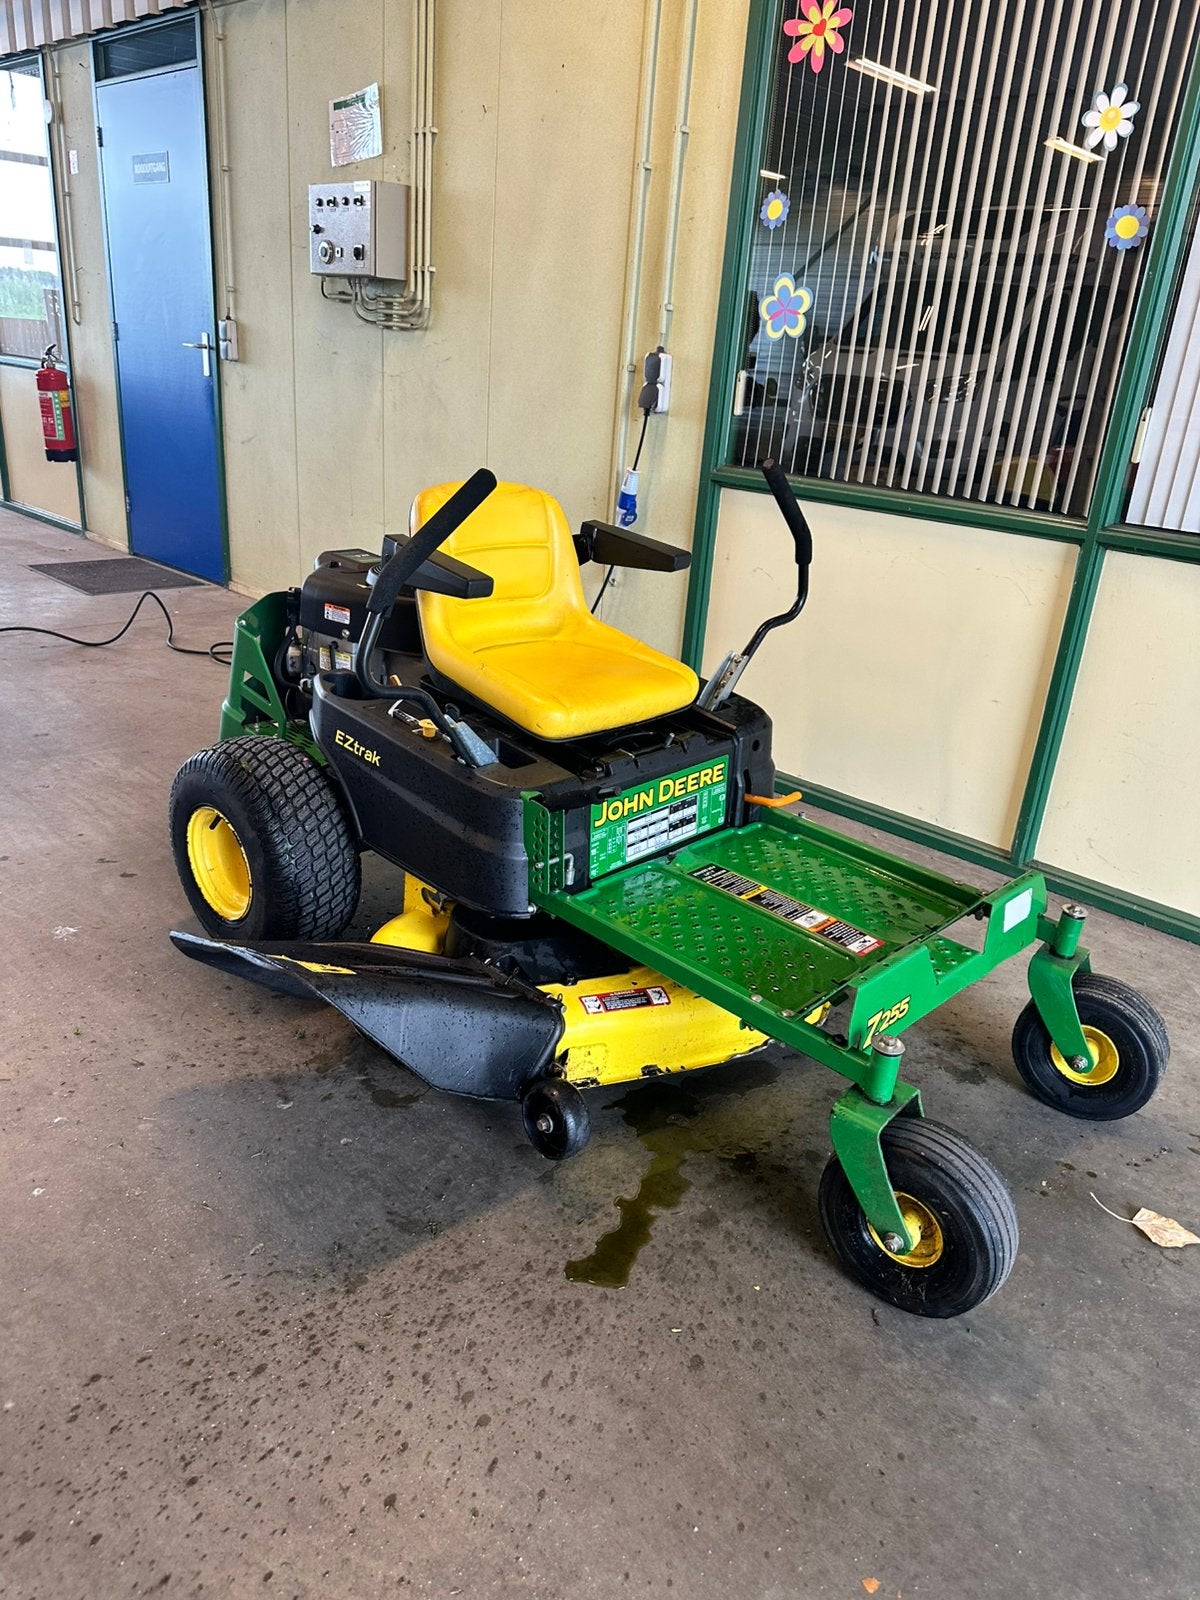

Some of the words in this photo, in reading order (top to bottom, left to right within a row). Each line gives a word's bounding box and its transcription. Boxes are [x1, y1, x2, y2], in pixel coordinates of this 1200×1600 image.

[334, 729, 382, 767] EZtrak
[593, 787, 655, 829] JOHN
[658, 762, 726, 804] DEERE
